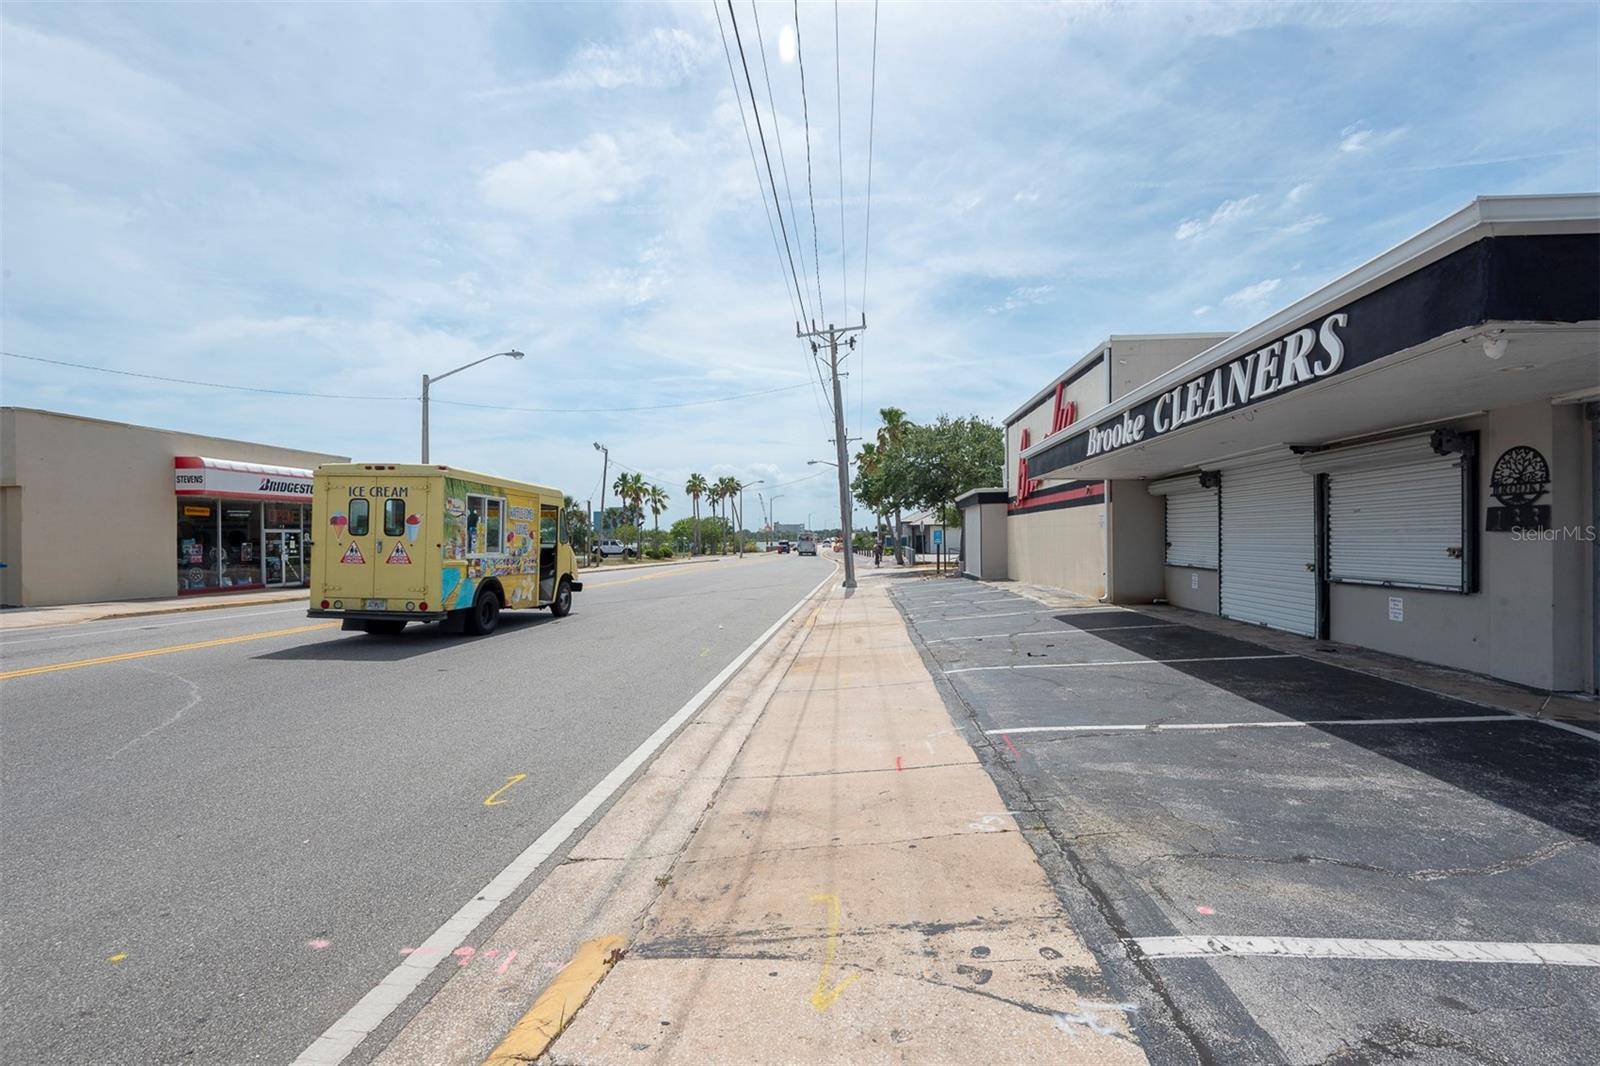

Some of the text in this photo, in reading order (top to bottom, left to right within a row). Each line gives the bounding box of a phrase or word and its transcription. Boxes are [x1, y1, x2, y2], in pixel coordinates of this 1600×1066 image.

[1086, 411, 1145, 456] Brooke
[1153, 314, 1348, 433] CLEANERS
[176, 475, 203, 484] STEVENS
[348, 486, 408, 498] ICE CREAM
